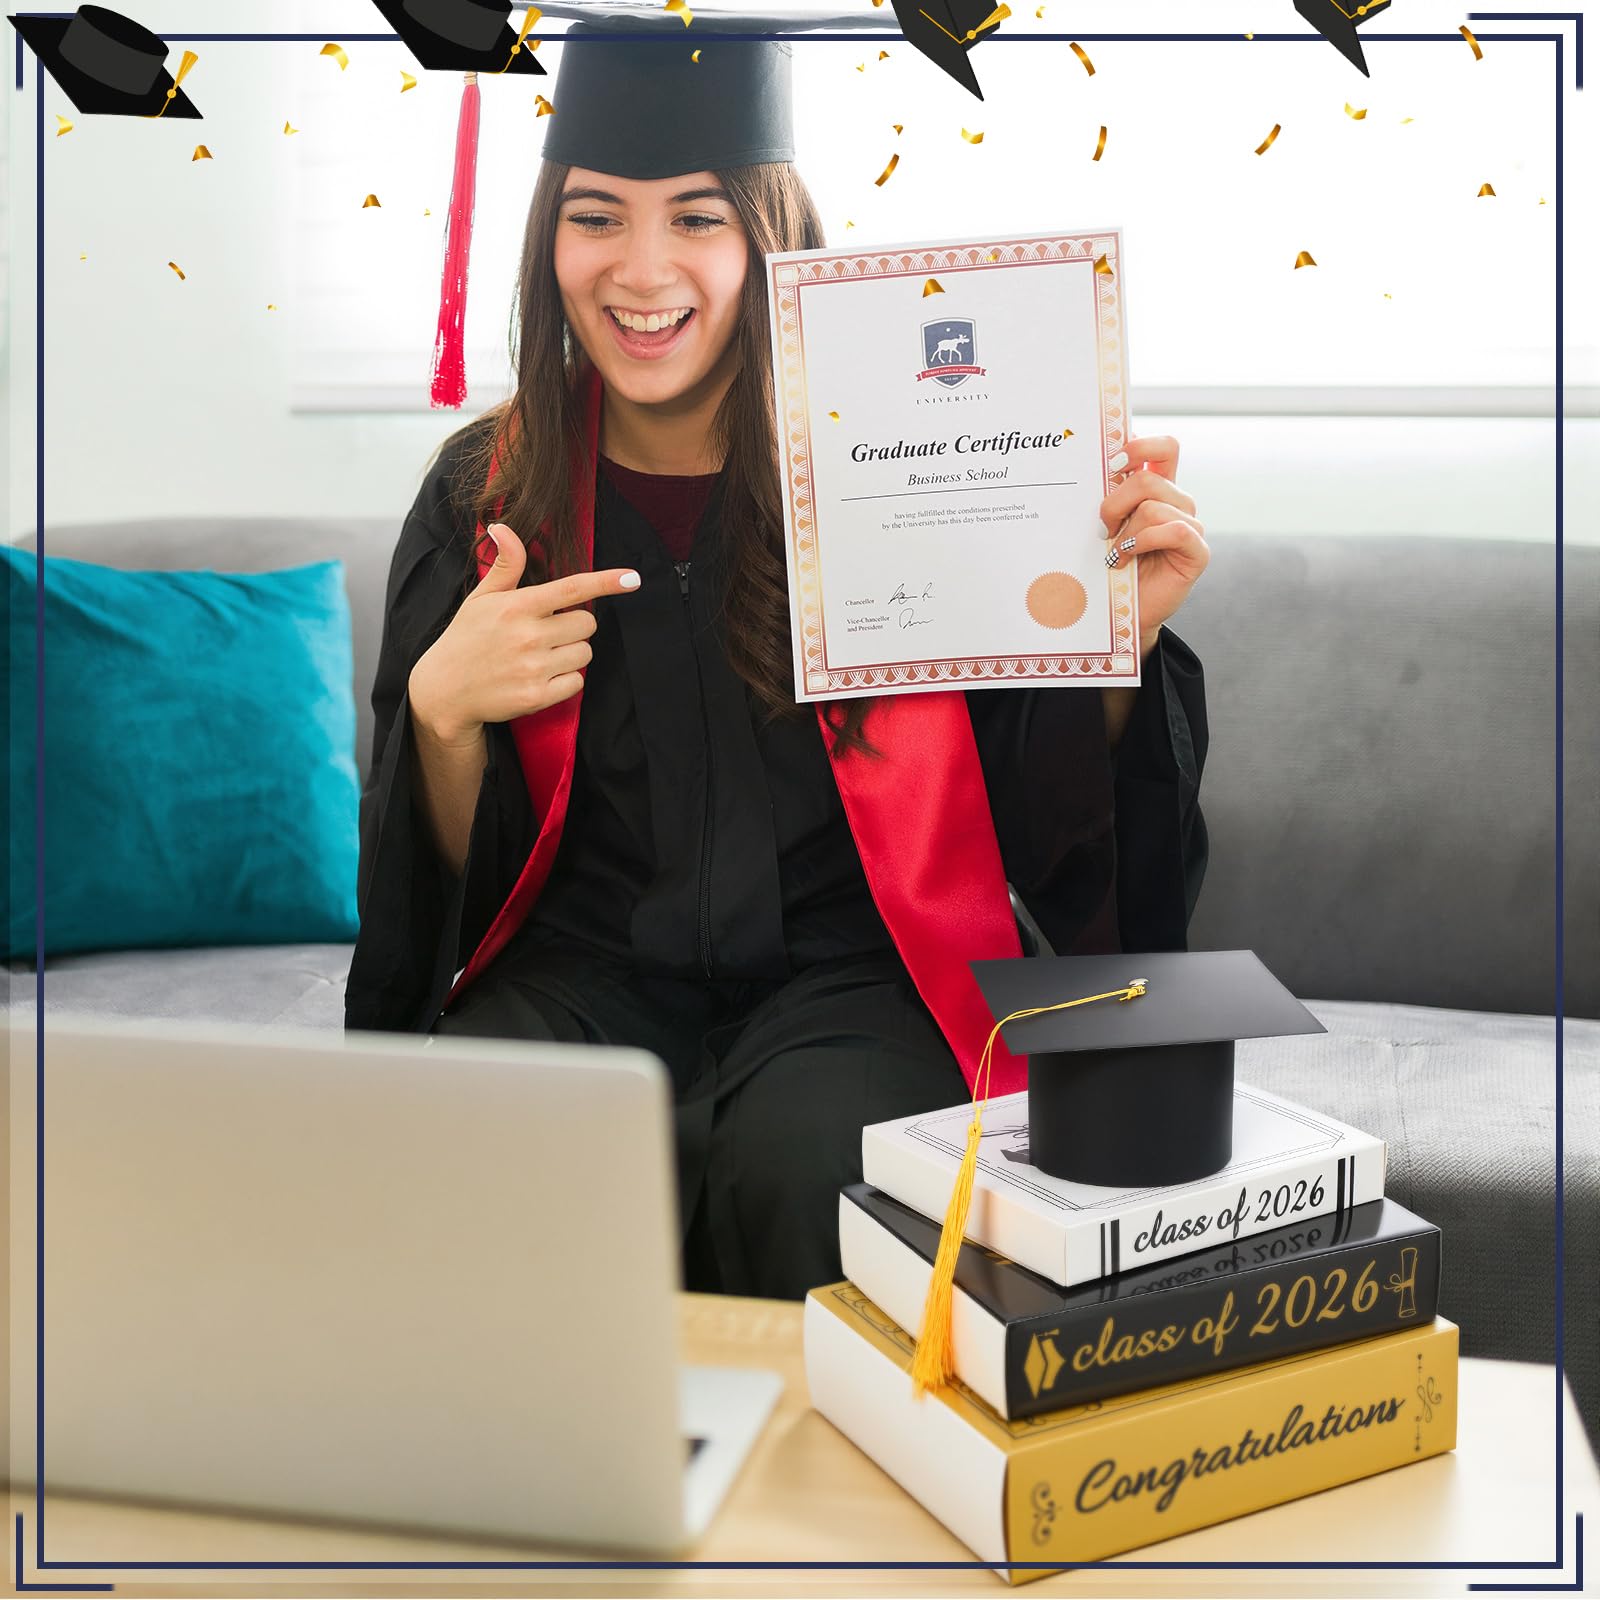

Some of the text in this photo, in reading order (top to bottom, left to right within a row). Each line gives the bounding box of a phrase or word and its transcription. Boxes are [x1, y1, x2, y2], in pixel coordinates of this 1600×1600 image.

[916, 393, 989, 405] UNIVERSITY
[851, 431, 1063, 462] Graduate Certificate
[907, 467, 1009, 486] Business School
[881, 523, 890, 531] by
[891, 520, 902, 529] the
[903, 518, 936, 529] University
[950, 516, 962, 524] this
[963, 515, 975, 525] day
[976, 514, 992, 522] been
[993, 511, 1024, 521] conferred
[1025, 511, 1039, 519] with
[894, 511, 916, 521] having
[958, 505, 990, 514] conditions
[992, 504, 1026, 513] prescribed
[846, 616, 890, 625] Vice-Chancellor
[859, 624, 883, 632] President
[1134, 1174, 1325, 1253] class of 2026
[1072, 1260, 1379, 1372] class of 2026
[1074, 1397, 1405, 1513] Congratulations
